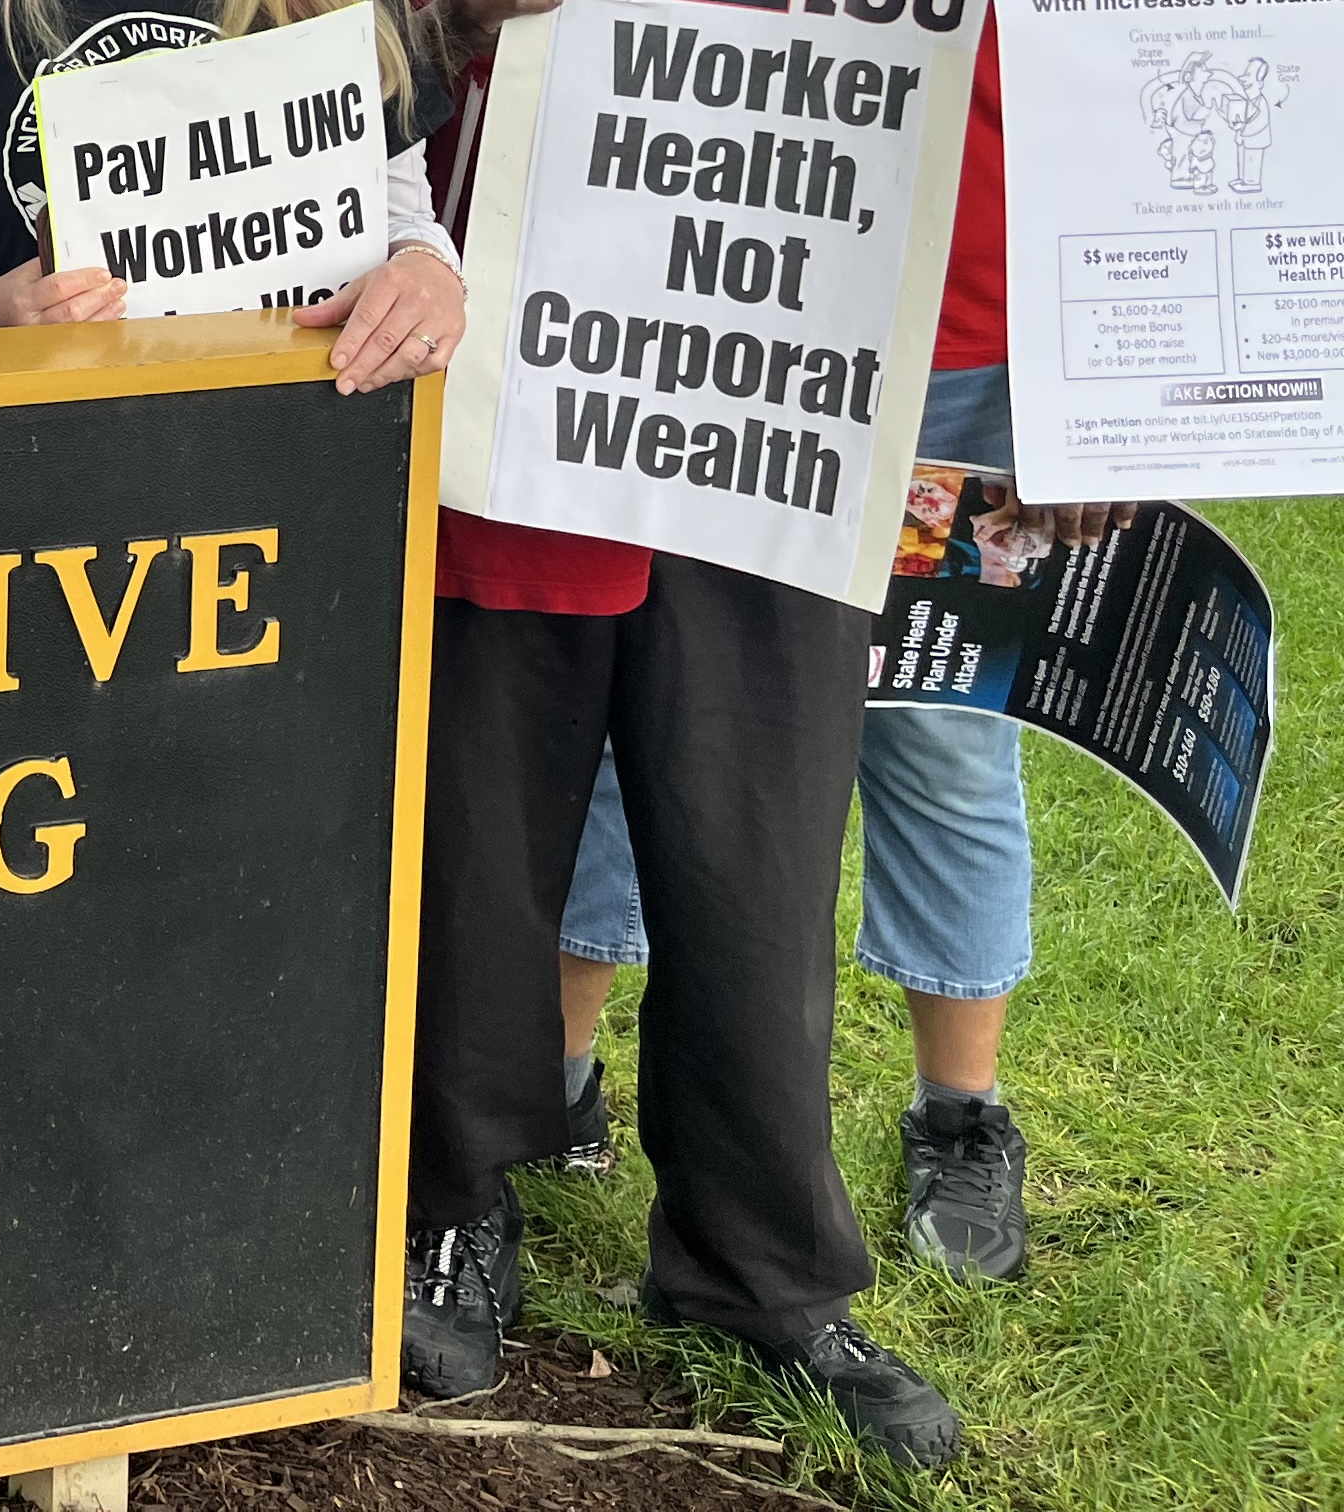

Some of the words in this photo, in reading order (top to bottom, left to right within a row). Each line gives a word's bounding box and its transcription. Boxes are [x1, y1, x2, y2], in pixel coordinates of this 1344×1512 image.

[613, 20, 920, 131] Worker
[74, 136, 166, 202] Pay
[189, 111, 272, 181] ALL
[283, 82, 364, 158] UNC
[586, 112, 875, 234] Health,
[101, 198, 323, 284] Workers
[336, 187, 364, 239] a
[666, 216, 811, 312] Not
[520, 292, 882, 426] Corporat
[555, 386, 843, 517] Wealth
[901, 600, 932, 647] Health
[934, 611, 960, 656] Under
[893, 649, 919, 687] State
[923, 657, 947, 690] Plan
[952, 642, 982, 693] Attack!
[1197, 666, 1221, 721] $50-180
[1173, 727, 1198, 782] $10-160
